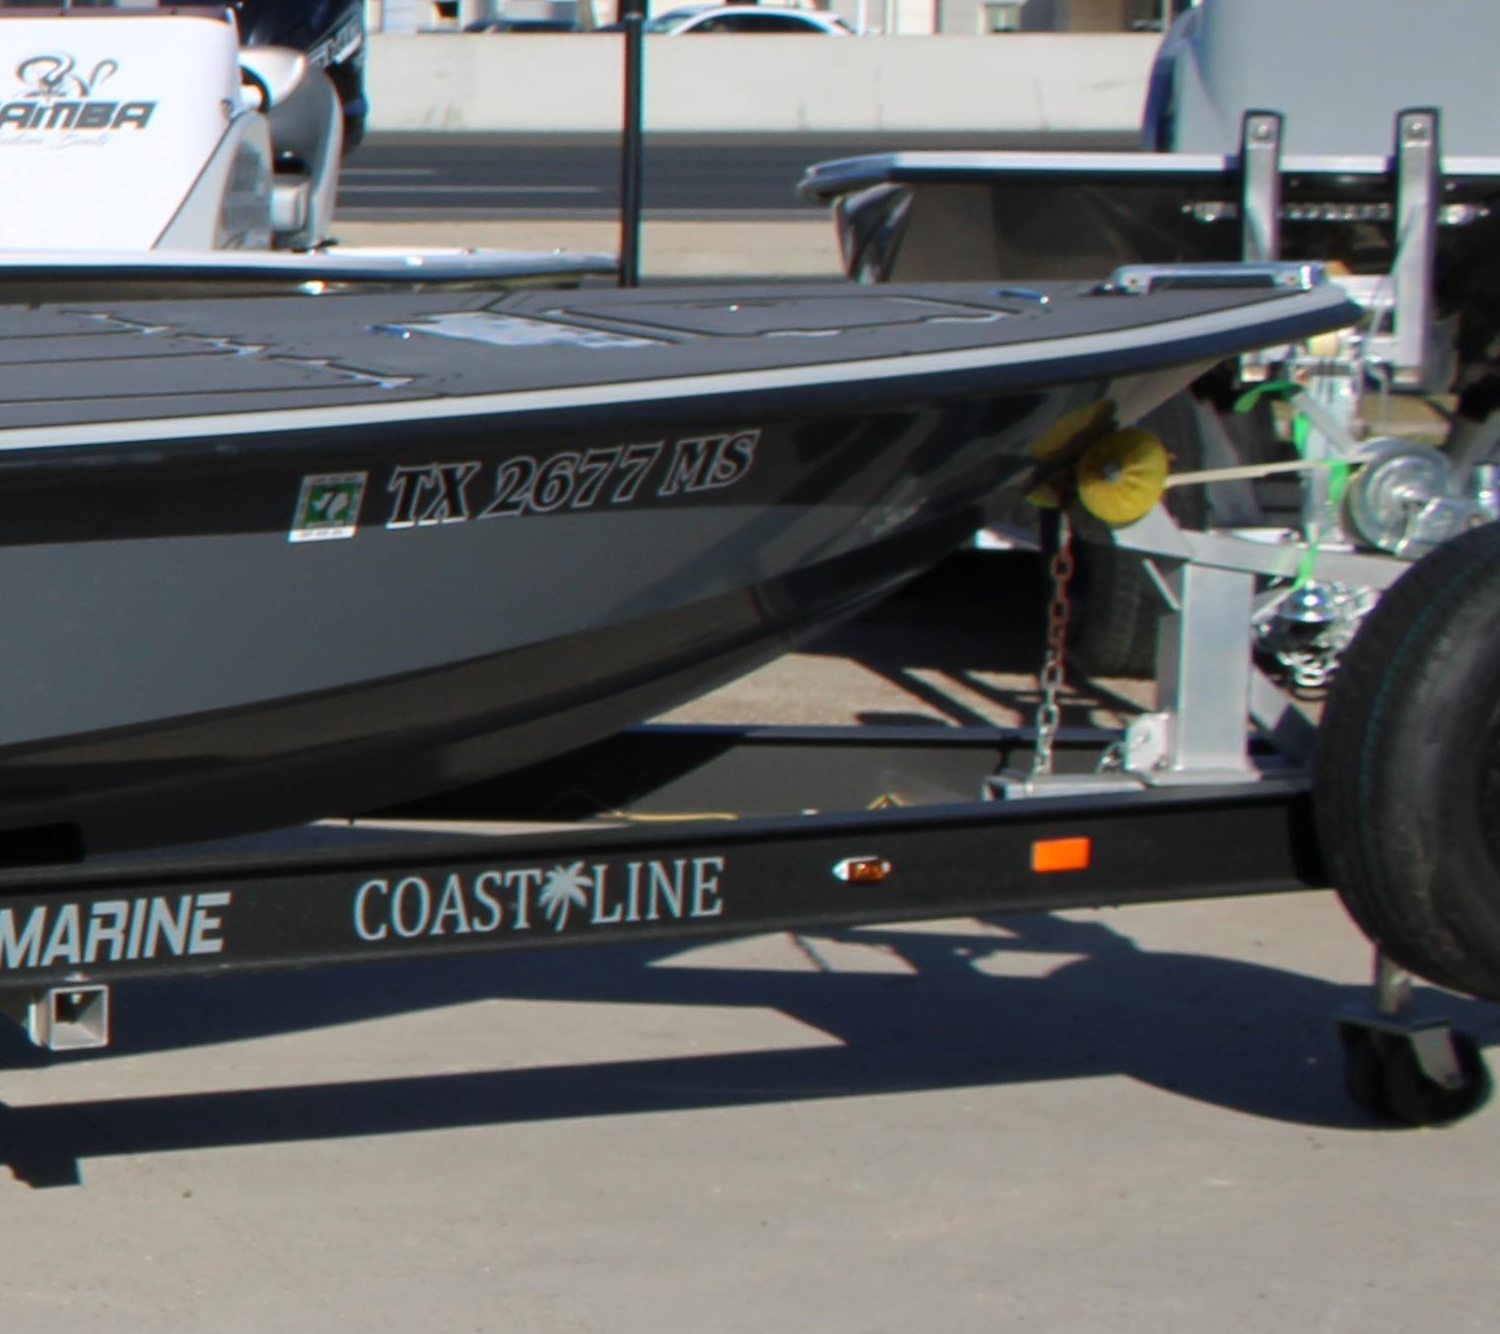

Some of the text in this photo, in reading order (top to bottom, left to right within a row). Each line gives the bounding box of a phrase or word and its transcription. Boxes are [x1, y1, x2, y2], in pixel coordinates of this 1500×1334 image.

[385, 429, 763, 529] TX 2677 MS
